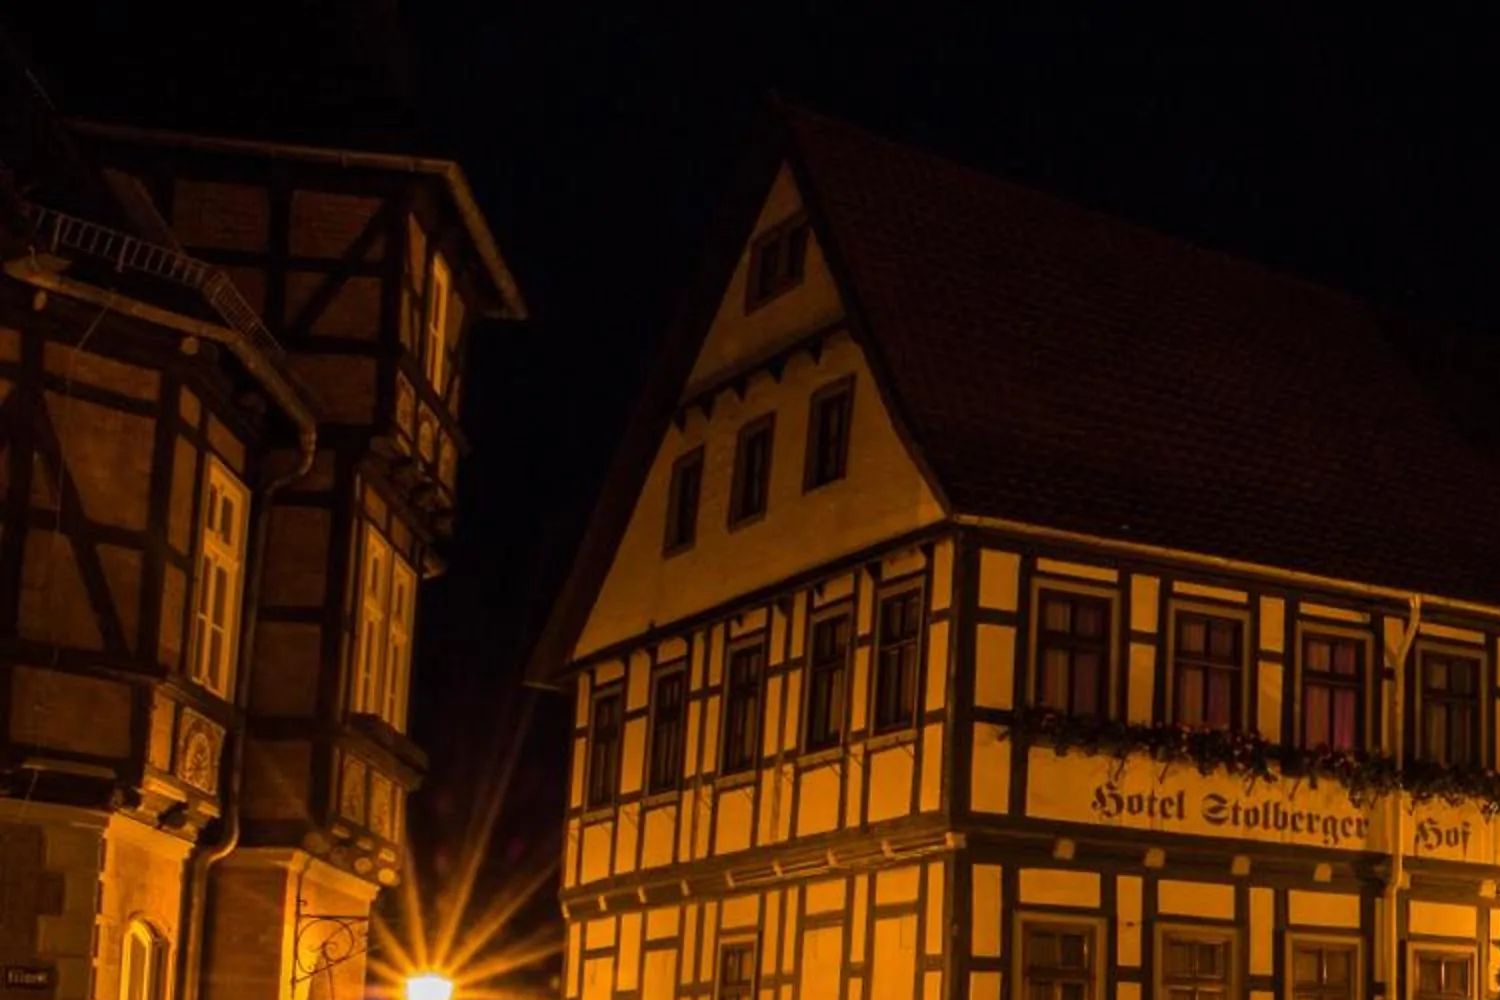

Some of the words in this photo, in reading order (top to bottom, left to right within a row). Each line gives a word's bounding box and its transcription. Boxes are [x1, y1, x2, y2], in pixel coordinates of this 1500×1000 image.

[1091, 781, 1186, 821] Hotel
[1202, 793, 1369, 846] Stolberger
[1414, 818, 1473, 855] Hof
